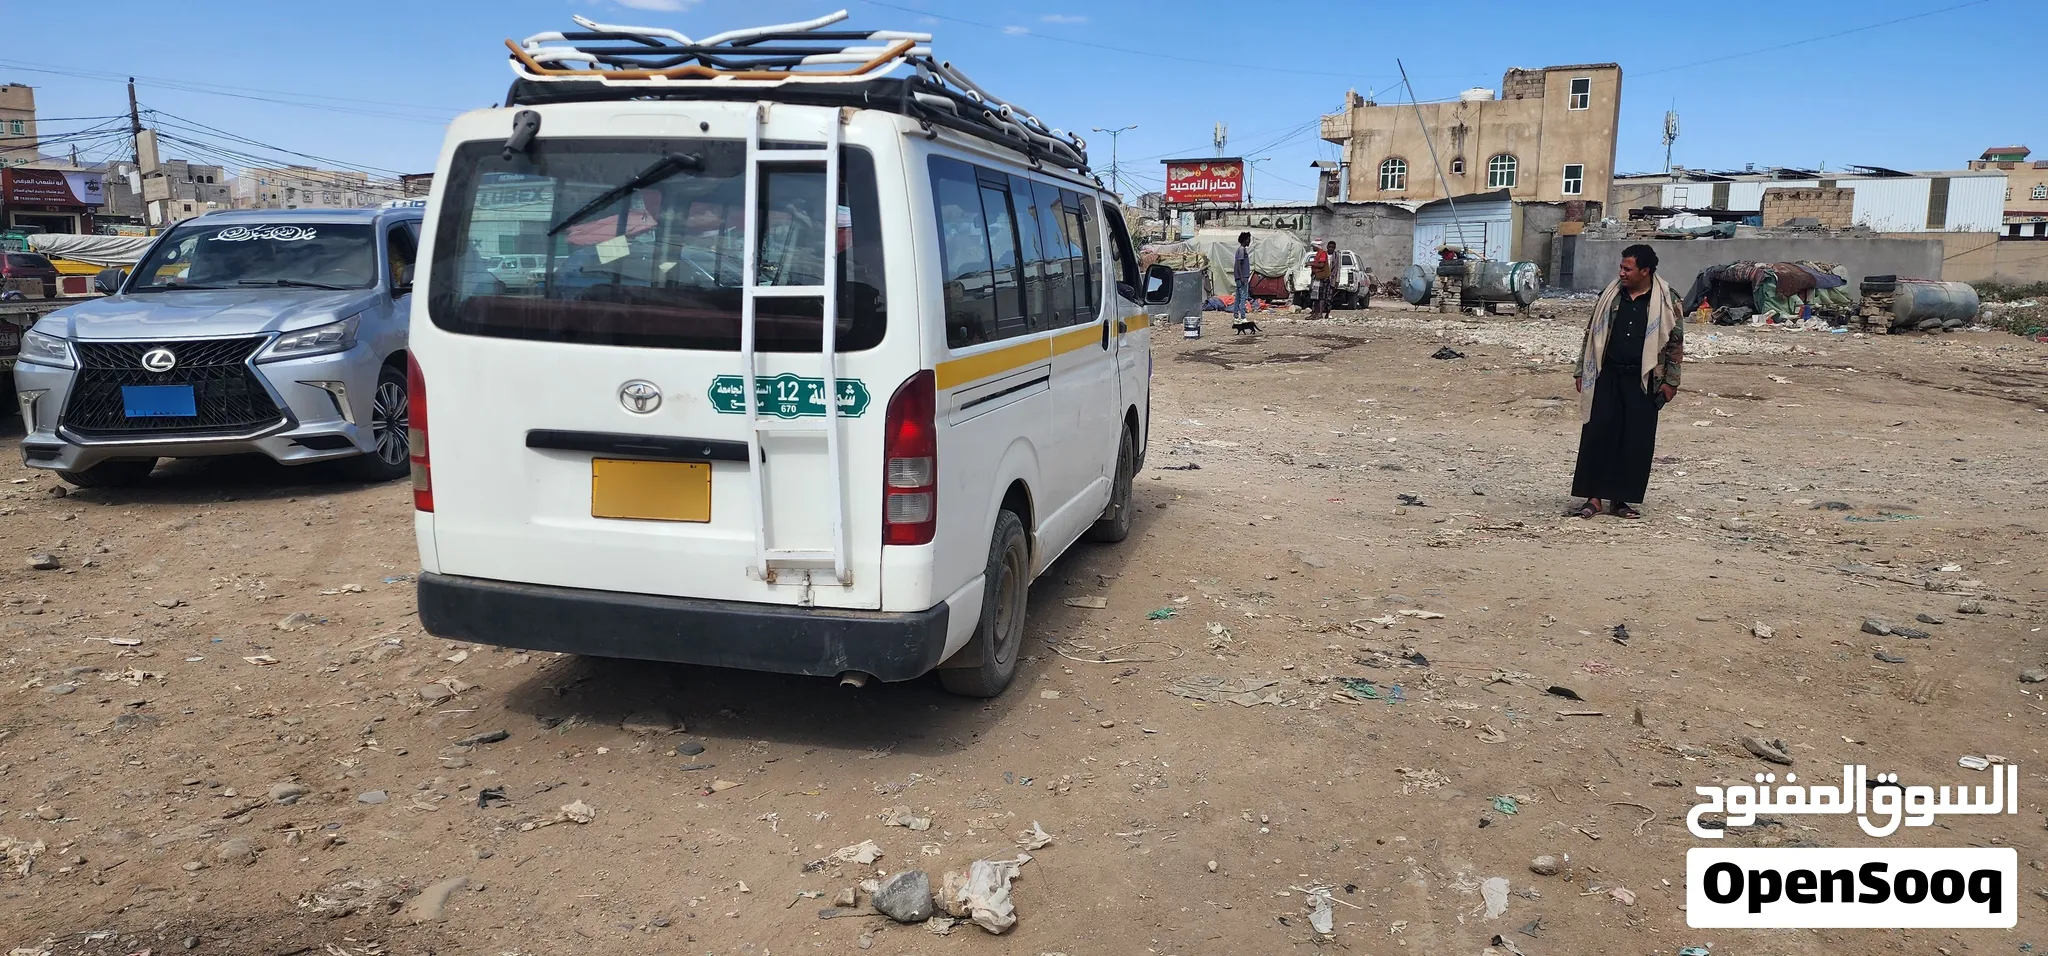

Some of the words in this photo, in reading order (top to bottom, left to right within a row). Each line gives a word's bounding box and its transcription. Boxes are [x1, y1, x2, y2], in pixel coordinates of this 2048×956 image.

[1170, 179, 1208, 193] التوحيد
[1209, 179, 1236, 192] مخابز
[716, 382, 744, 397] لجامعة
[777, 380, 800, 402] 12
[808, 383, 856, 408] شملة
[781, 404, 797, 413] 670
